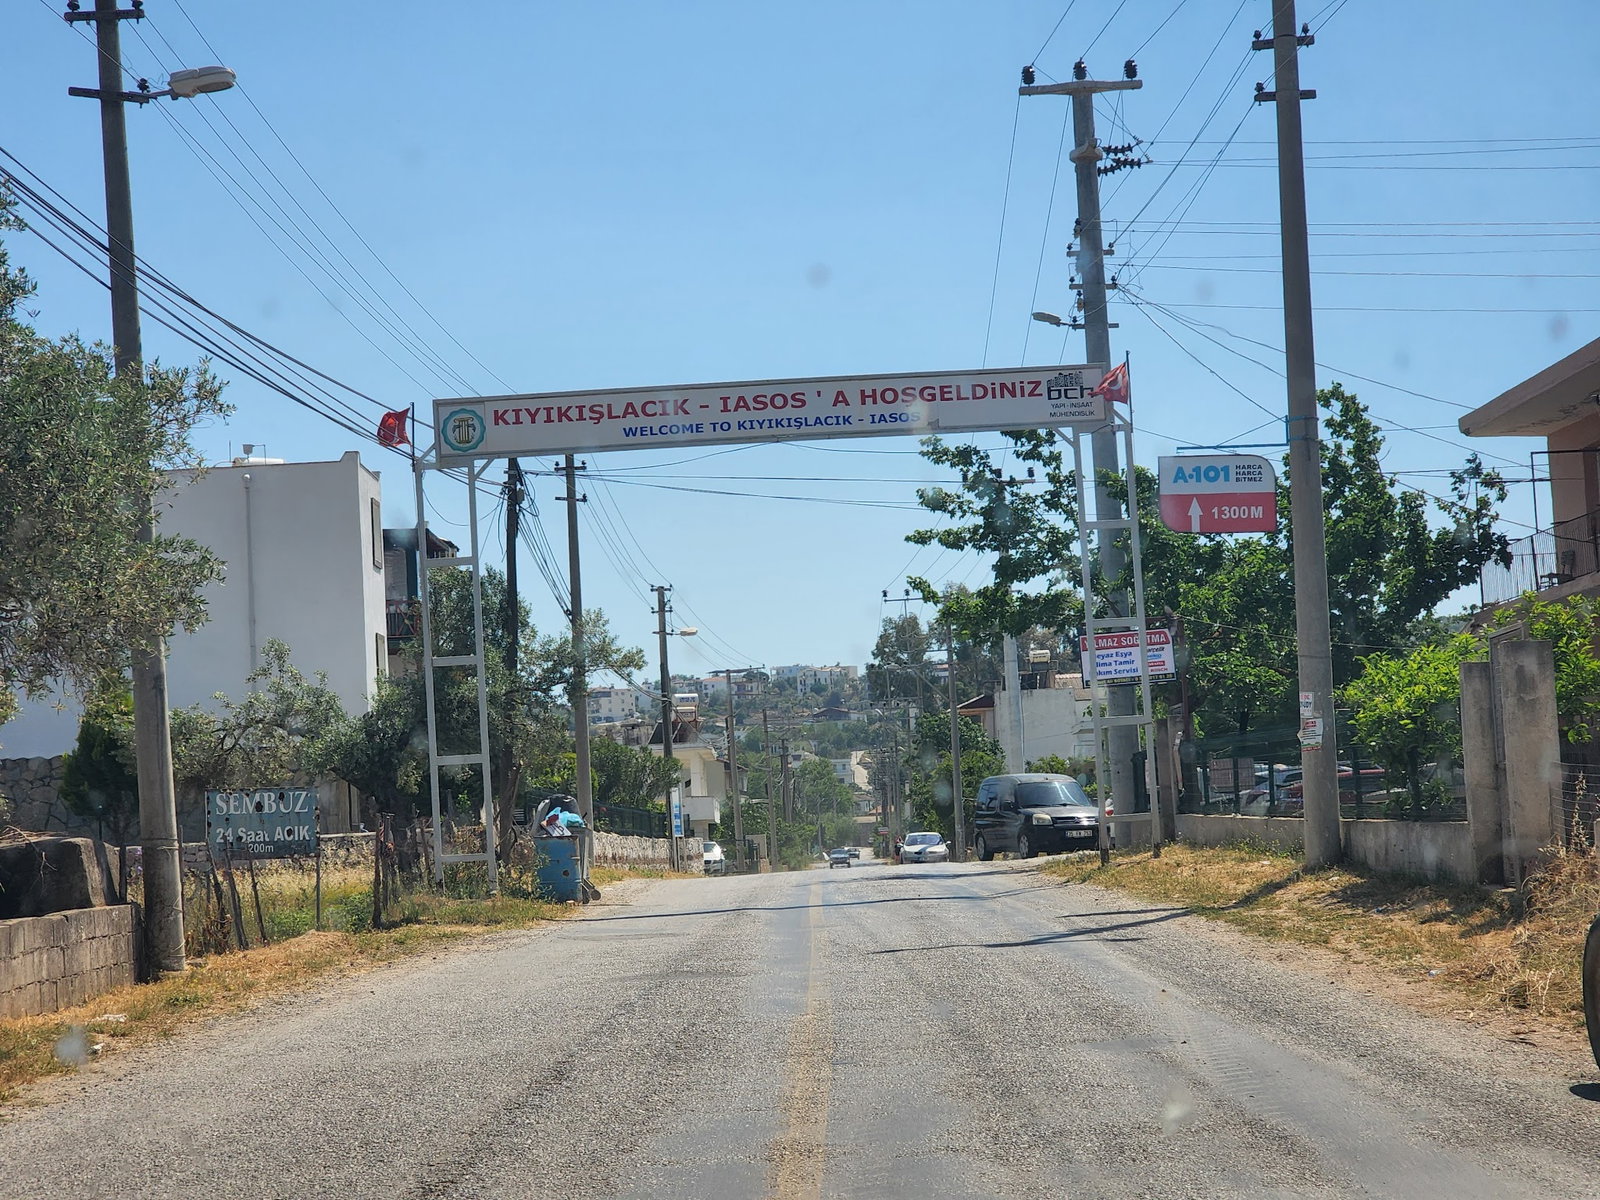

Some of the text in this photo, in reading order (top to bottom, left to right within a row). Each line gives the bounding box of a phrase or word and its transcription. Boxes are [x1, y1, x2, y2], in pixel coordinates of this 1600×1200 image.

[493, 398, 691, 426] KIYIKIŞLACIK
[719, 390, 808, 413] IASOS
[622, 422, 705, 438] WELCOME
[709, 421, 732, 432] TO
[737, 414, 853, 430] KIYIKIŞLACIK
[869, 411, 921, 425] IASOS
[1120, 633, 1167, 646] SOĞTMA
[1096, 652, 1114, 660] eyaz
[1114, 658, 1136, 667] Tamir
[1113, 666, 1139, 676] Servisi
[215, 791, 309, 815] SEMBUZ
[215, 827, 233, 843] 24
[237, 827, 269, 843] Saat
